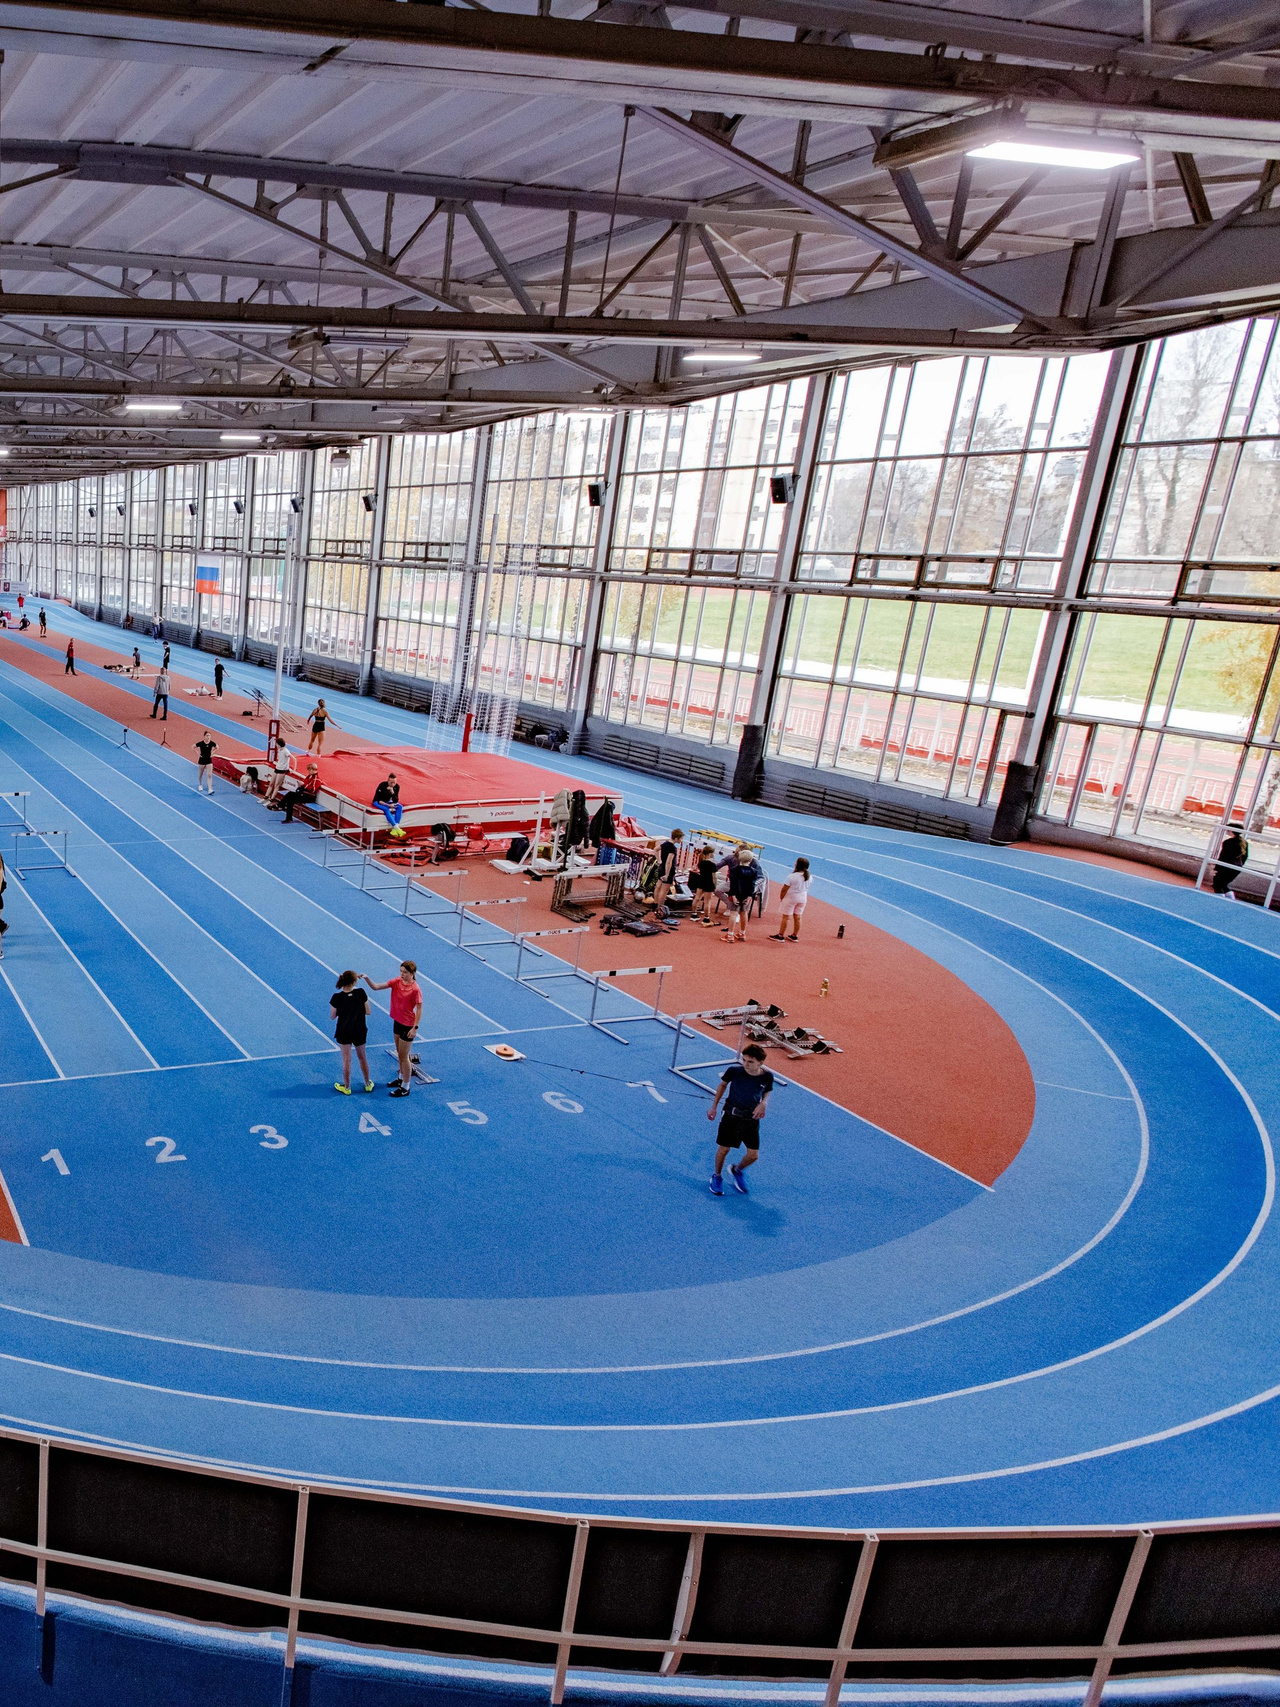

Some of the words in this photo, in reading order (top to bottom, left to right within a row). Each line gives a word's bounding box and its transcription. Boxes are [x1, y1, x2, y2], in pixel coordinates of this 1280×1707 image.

[40, 1149, 70, 1176] 1
[145, 1136, 187, 1164] 2
[249, 1124, 289, 1149] 3
[358, 1112, 392, 1136] 4
[446, 1101, 489, 1125] 5
[542, 1091, 584, 1114] 6
[625, 1080, 669, 1103] 7
